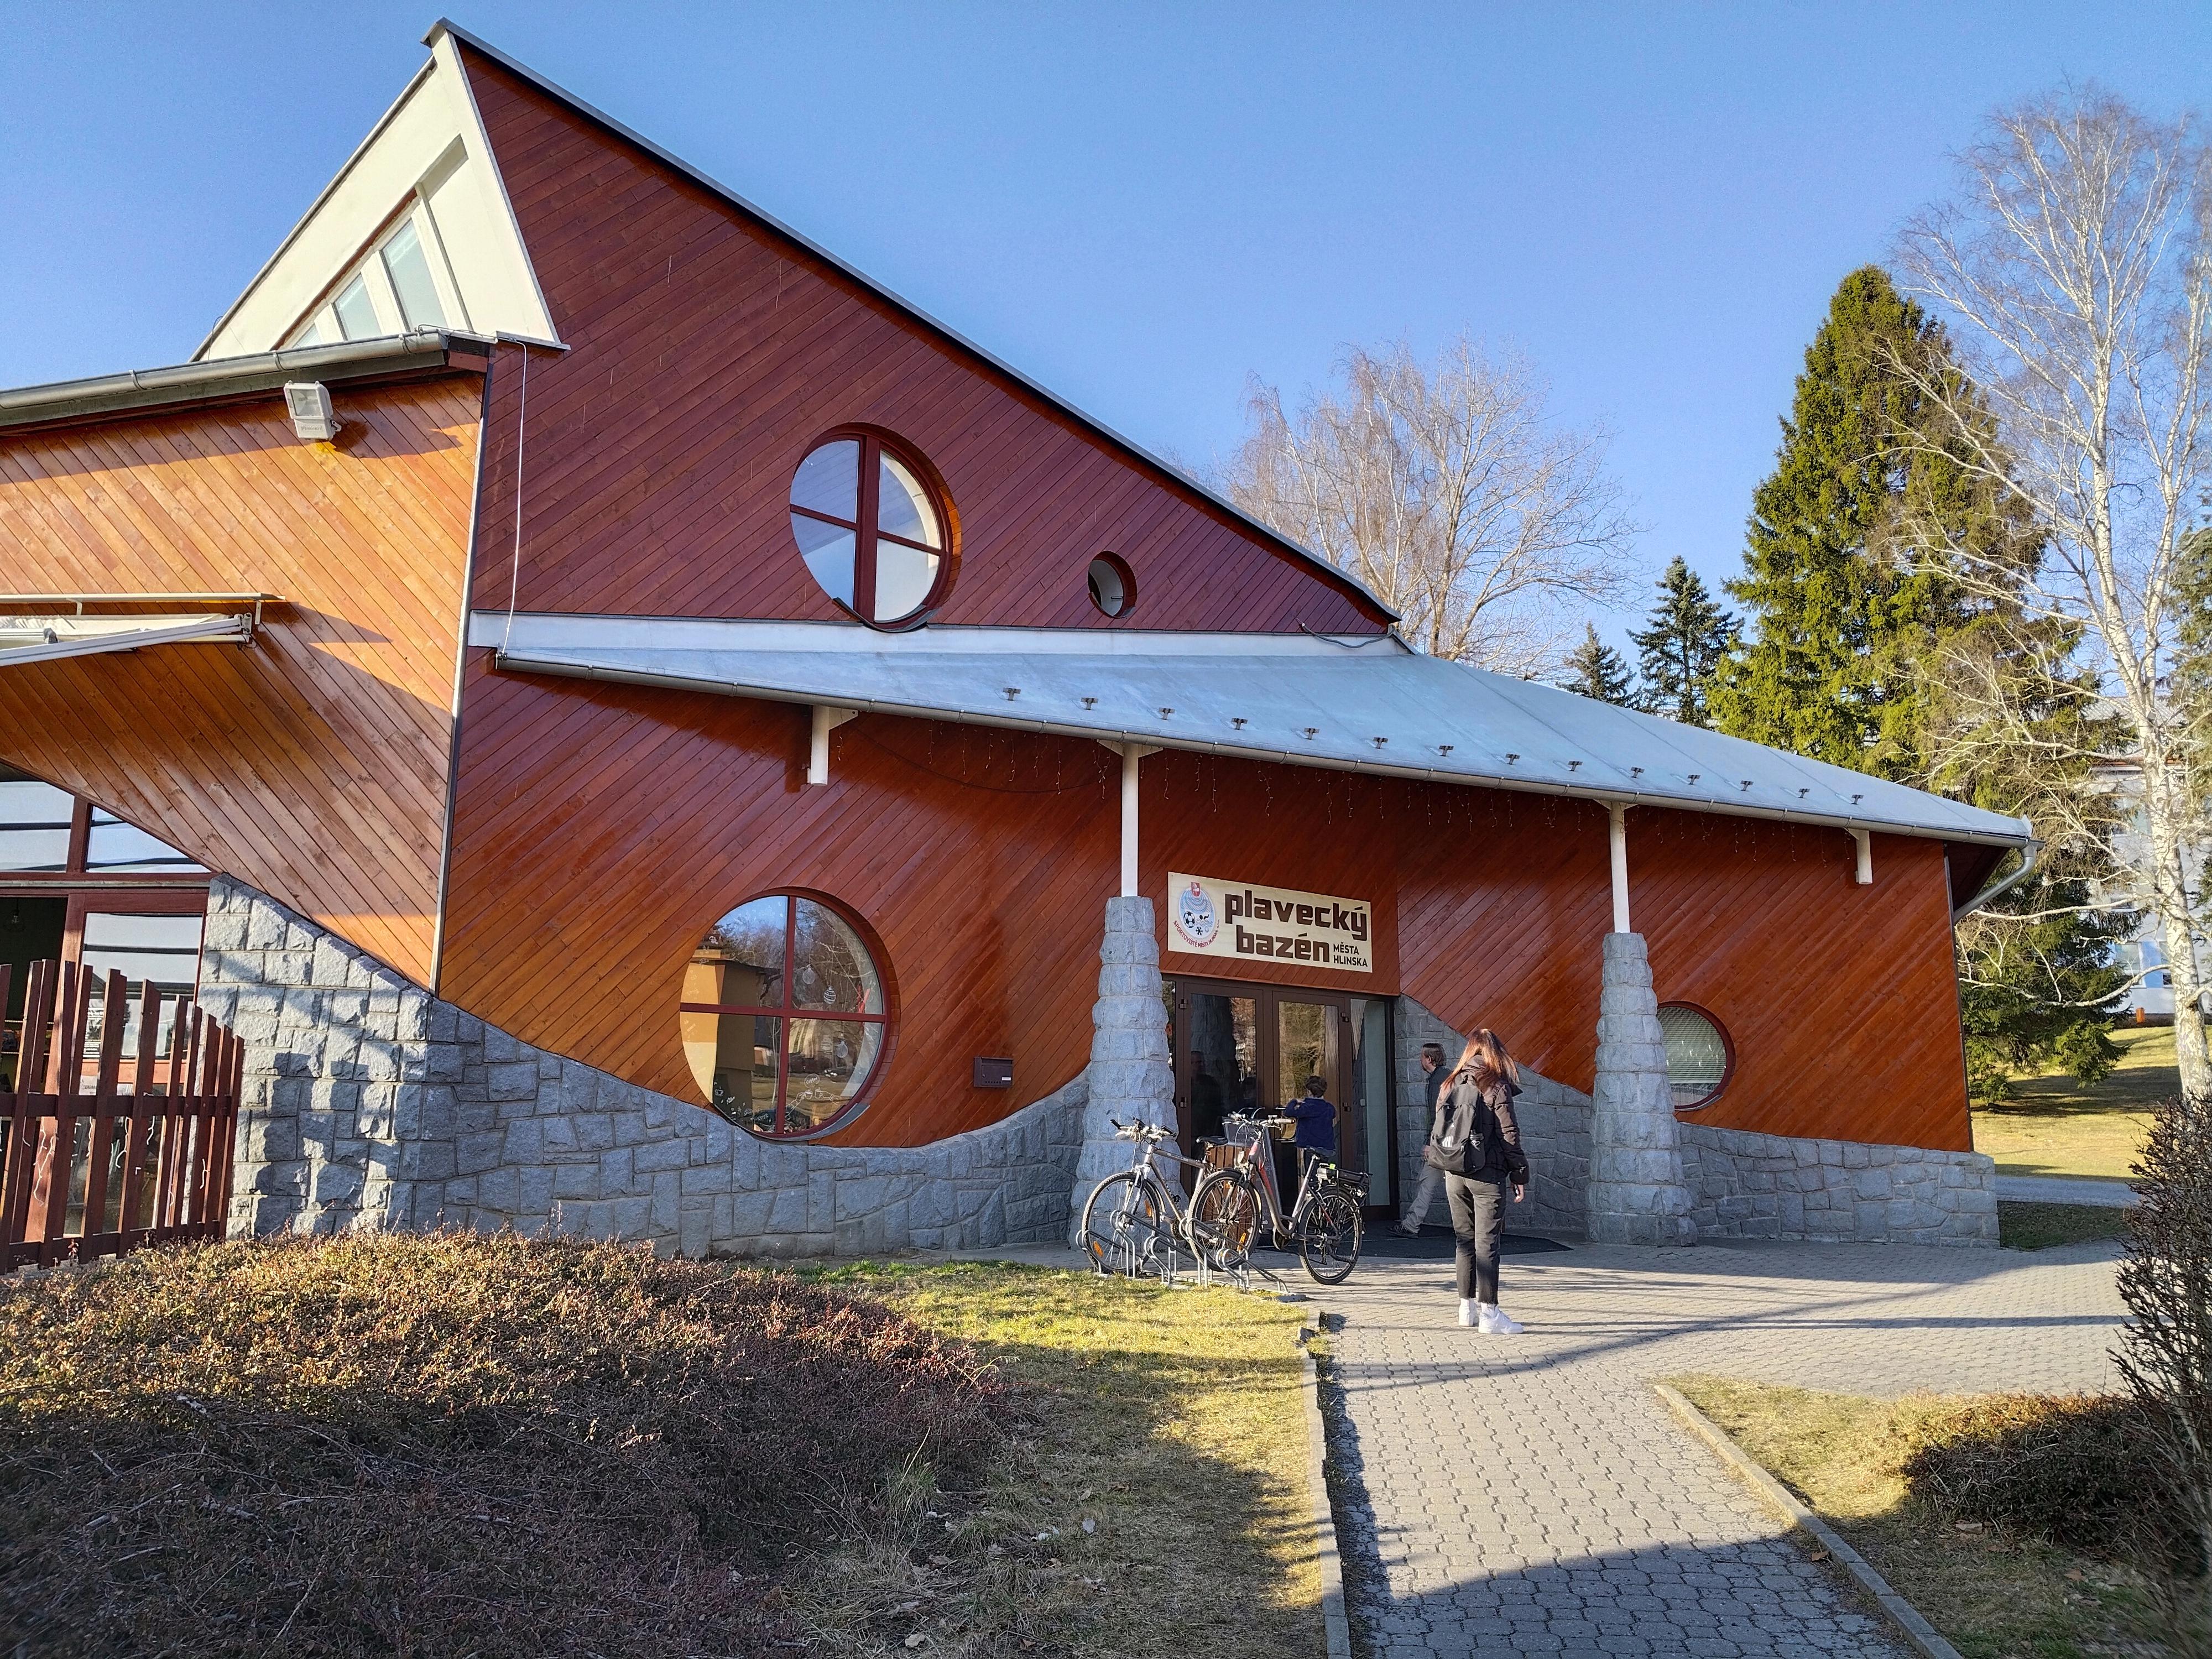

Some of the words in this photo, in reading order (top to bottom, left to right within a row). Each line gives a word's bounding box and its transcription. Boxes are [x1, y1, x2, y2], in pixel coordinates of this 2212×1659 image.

[1225, 890, 1367, 941] plavecký
[1237, 925, 1330, 962] bazén
[1333, 942, 1359, 955] MĚSTA
[1333, 956, 1368, 967] HLINSKA
